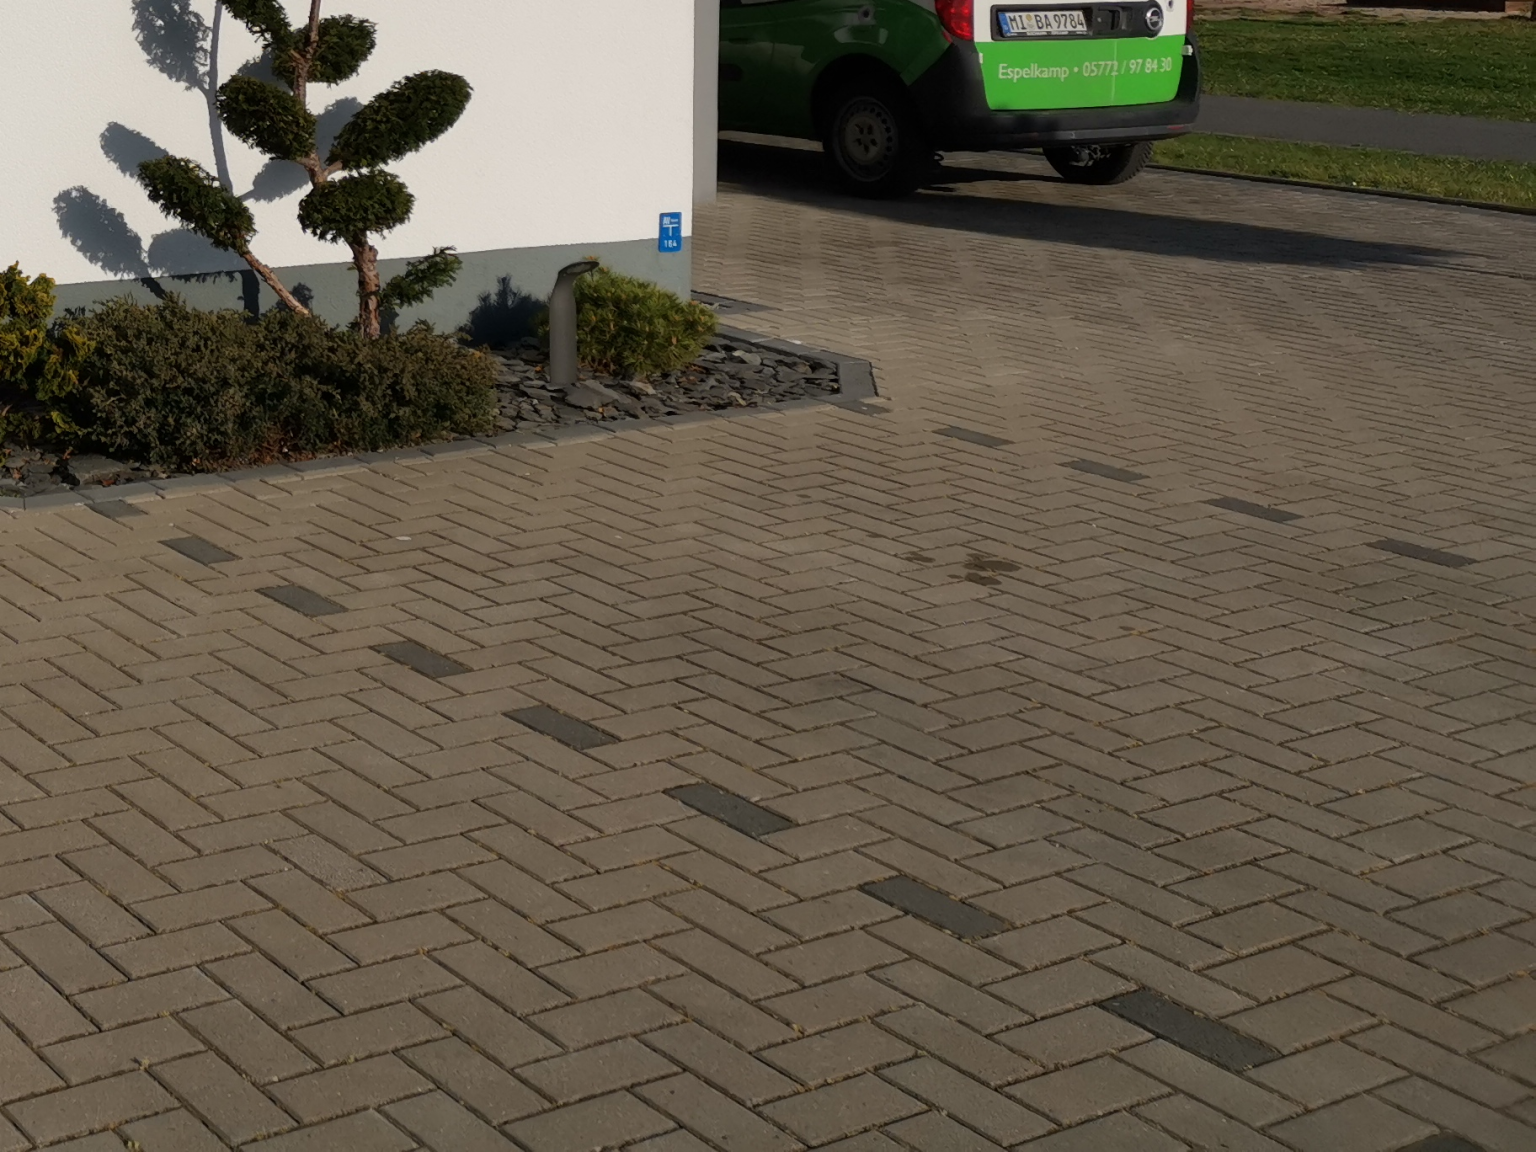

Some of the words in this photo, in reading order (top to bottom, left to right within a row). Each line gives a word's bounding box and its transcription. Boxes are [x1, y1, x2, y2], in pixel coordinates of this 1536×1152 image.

[1008, 14, 1027, 30] MI
[1034, 13, 1053, 30] BA
[1053, 13, 1085, 29] 9784
[998, 63, 1070, 83] Espelkamp
[1082, 60, 1119, 77] 05772
[1128, 58, 1144, 74] 97
[1144, 58, 1158, 74] 84
